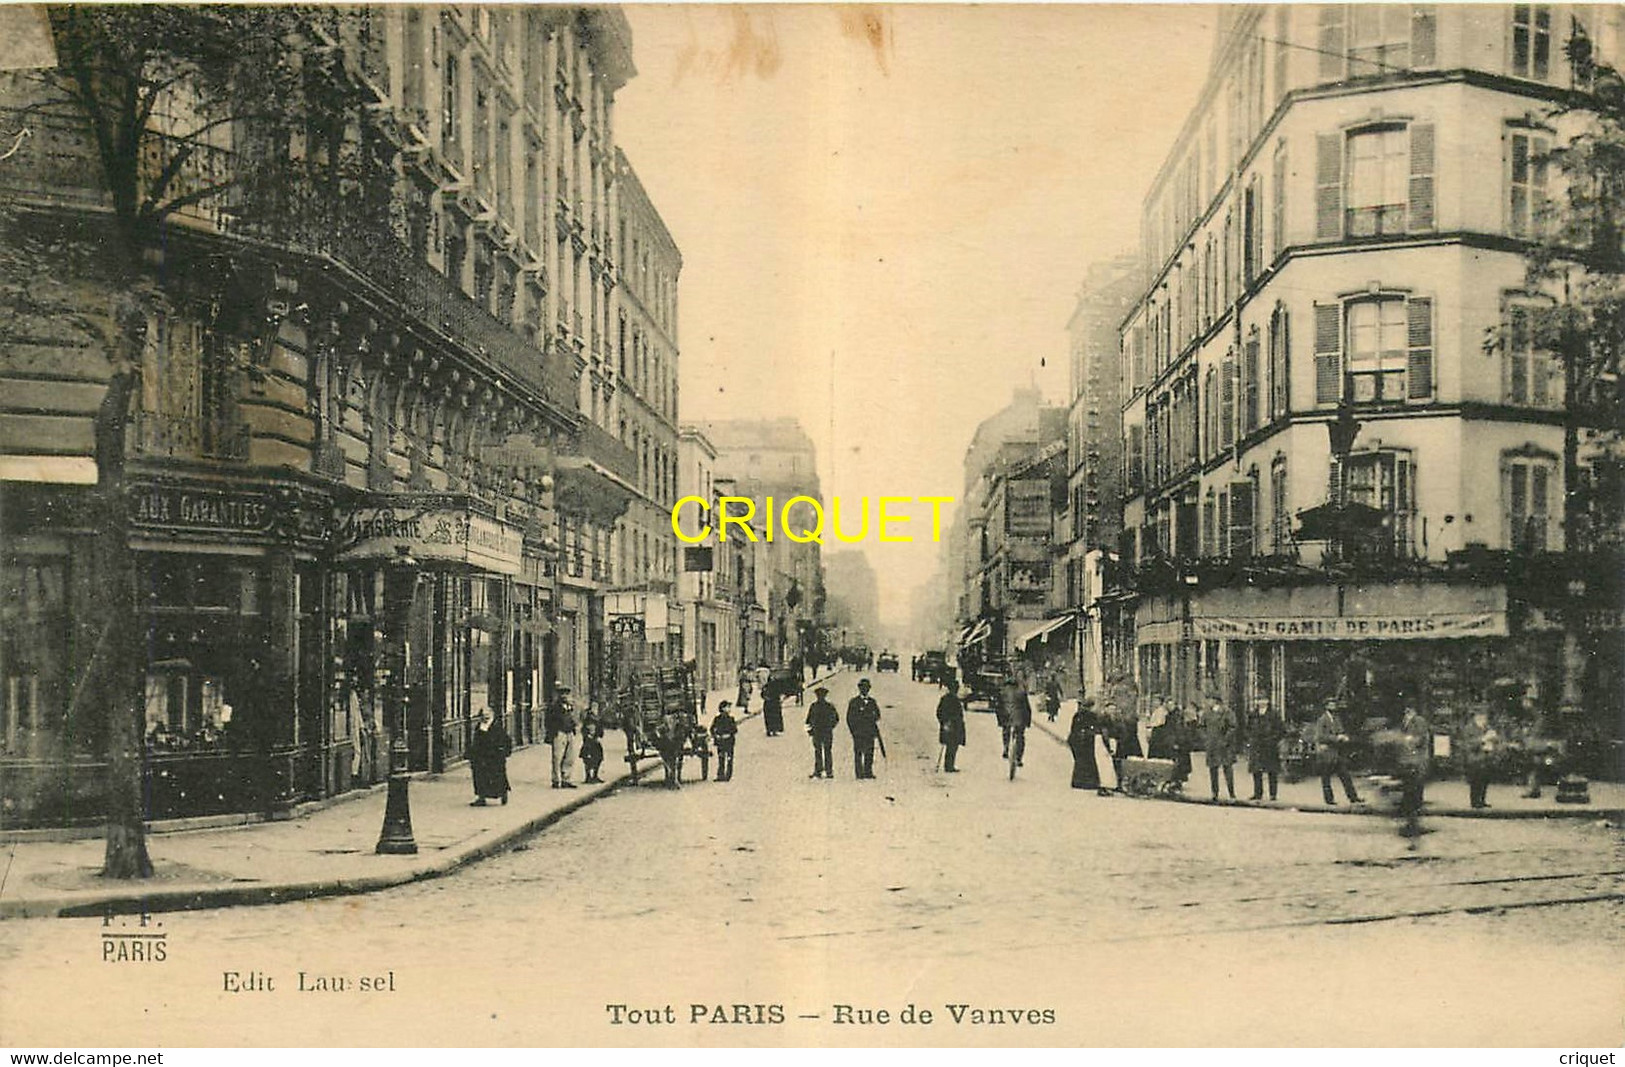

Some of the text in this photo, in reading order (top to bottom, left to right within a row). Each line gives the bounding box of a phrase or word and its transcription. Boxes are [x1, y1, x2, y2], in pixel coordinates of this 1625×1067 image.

[136, 493, 170, 521] AUX
[615, 622, 639, 632] BAR
[1245, 621, 1269, 635] AU
[1276, 621, 1337, 635] GAMIN
[1346, 620, 1368, 633] DE
[1377, 619, 1435, 633] PARIS
